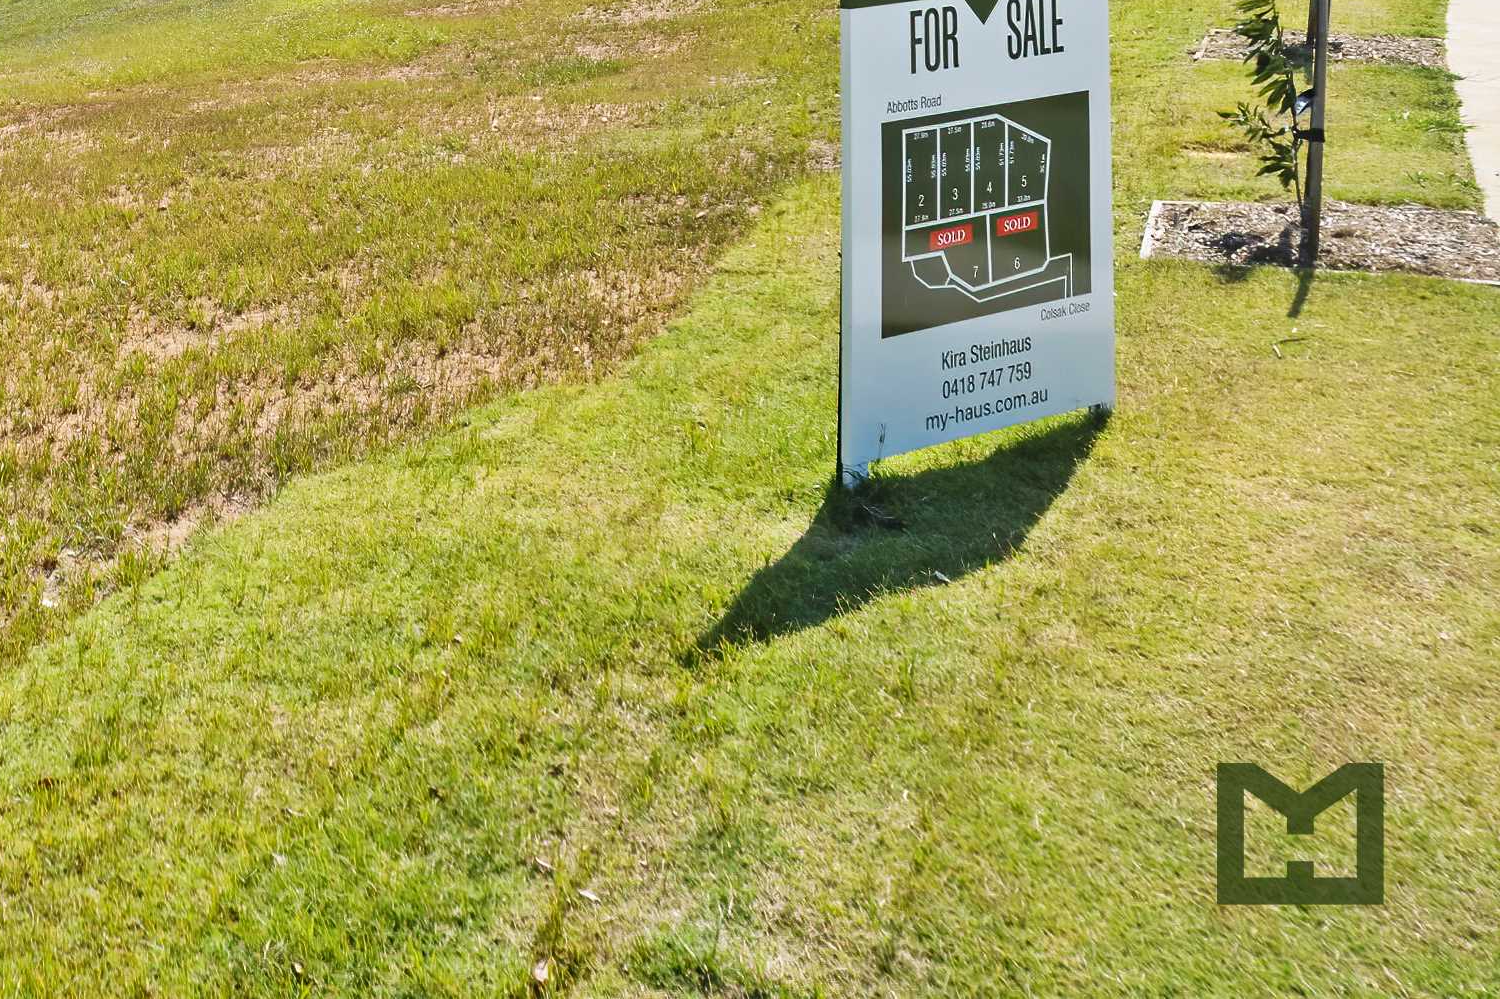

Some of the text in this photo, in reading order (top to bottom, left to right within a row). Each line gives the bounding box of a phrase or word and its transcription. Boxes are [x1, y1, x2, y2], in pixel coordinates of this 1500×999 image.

[909, 6, 959, 74] FOR
[886, 94, 941, 114] Abbotts Road
[986, 181, 992, 193] 4
[1021, 175, 1028, 188] 5
[918, 194, 925, 207] 2
[952, 187, 959, 200] 3
[1003, 216, 1031, 232] SOLD
[937, 229, 965, 246] SOLD
[1014, 256, 1021, 270] 6
[972, 265, 979, 279] 7
[1069, 302, 1090, 315] Close
[941, 336, 1032, 370] Kira Steinhaus
[942, 361, 1032, 399] 0418 747 759
[925, 388, 1048, 432] my-haus.com.au
